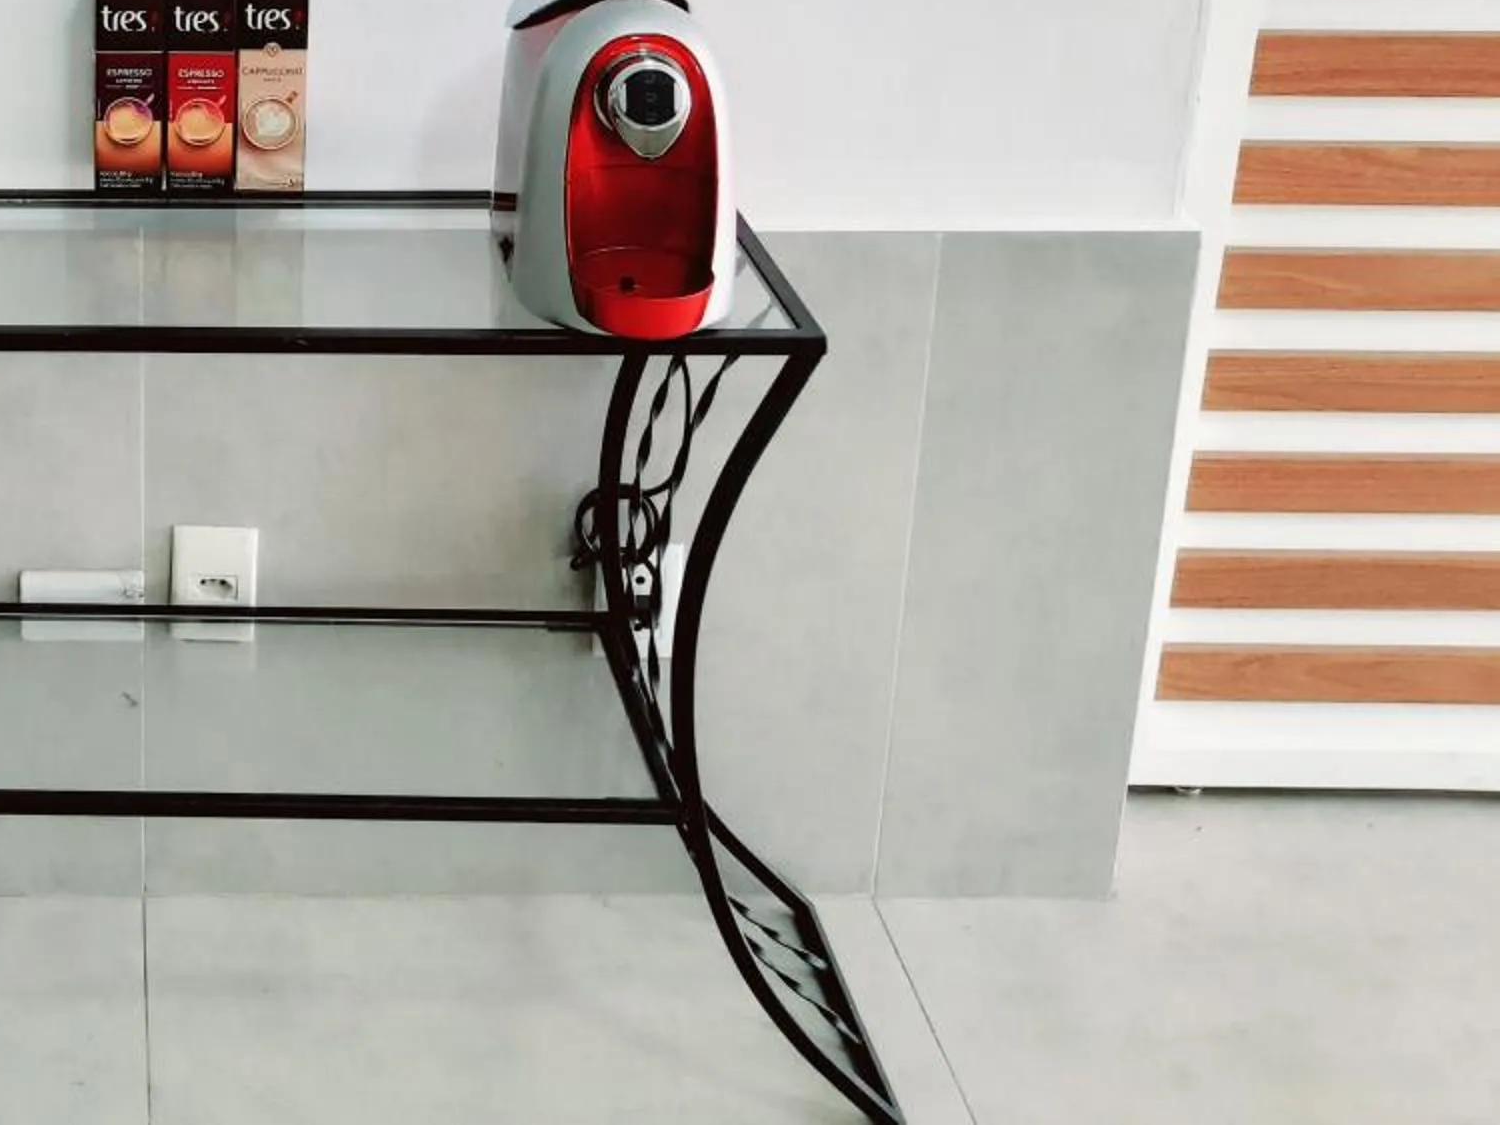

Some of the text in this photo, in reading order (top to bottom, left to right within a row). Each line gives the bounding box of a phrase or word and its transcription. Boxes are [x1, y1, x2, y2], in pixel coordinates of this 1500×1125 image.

[100, 5, 147, 32] tres
[174, 6, 220, 32] tres
[245, 3, 291, 30] tres
